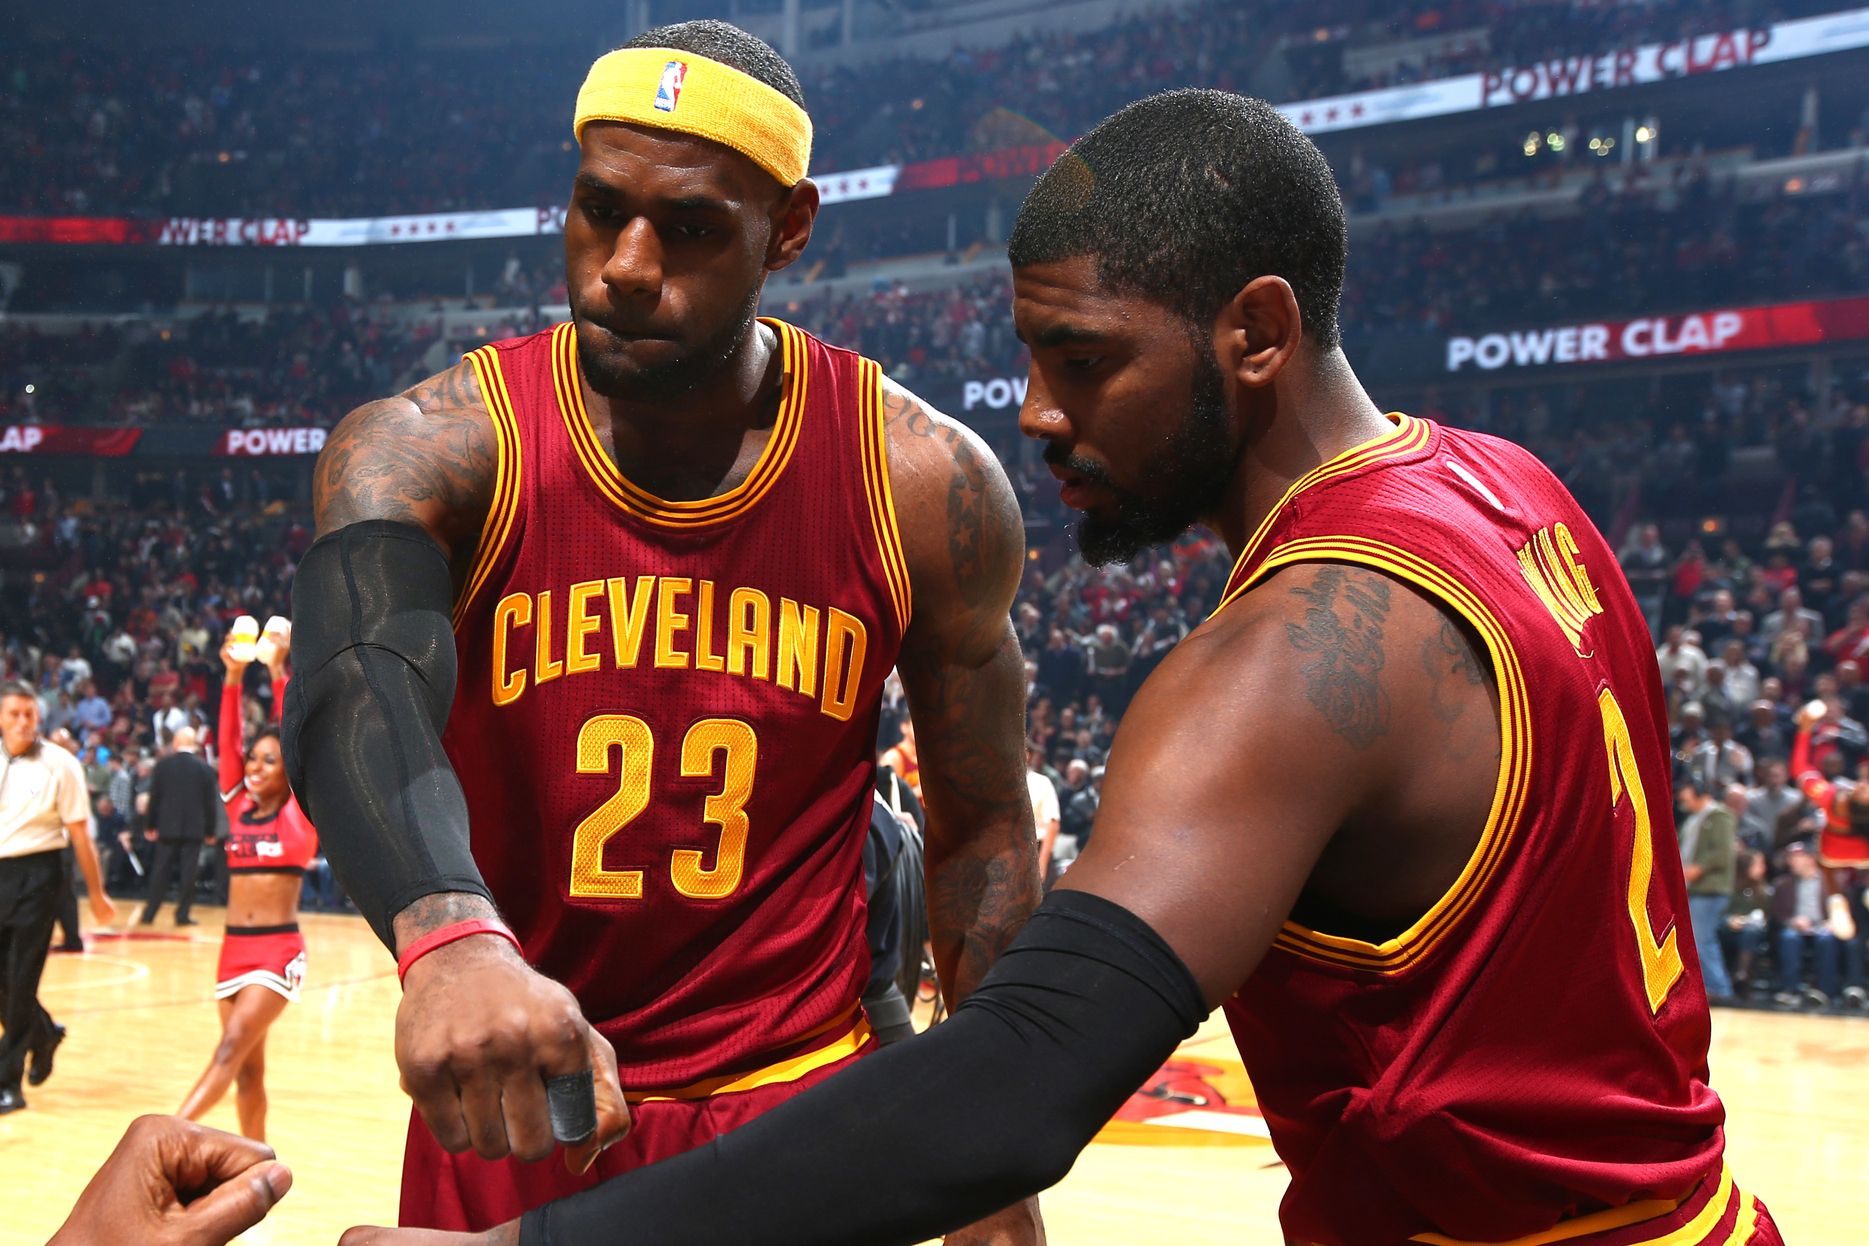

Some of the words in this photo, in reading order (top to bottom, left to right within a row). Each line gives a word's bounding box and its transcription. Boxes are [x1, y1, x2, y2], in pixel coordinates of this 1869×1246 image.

[1482, 45, 1637, 106] POWER
[1656, 28, 1770, 76] CLAP
[1446, 324, 1610, 371] POWER
[1621, 311, 1742, 356] CLAP
[227, 427, 328, 455] POWER
[492, 575, 868, 722] CLEVELAND
[569, 714, 758, 899] 23
[1598, 687, 1685, 1015] 2
